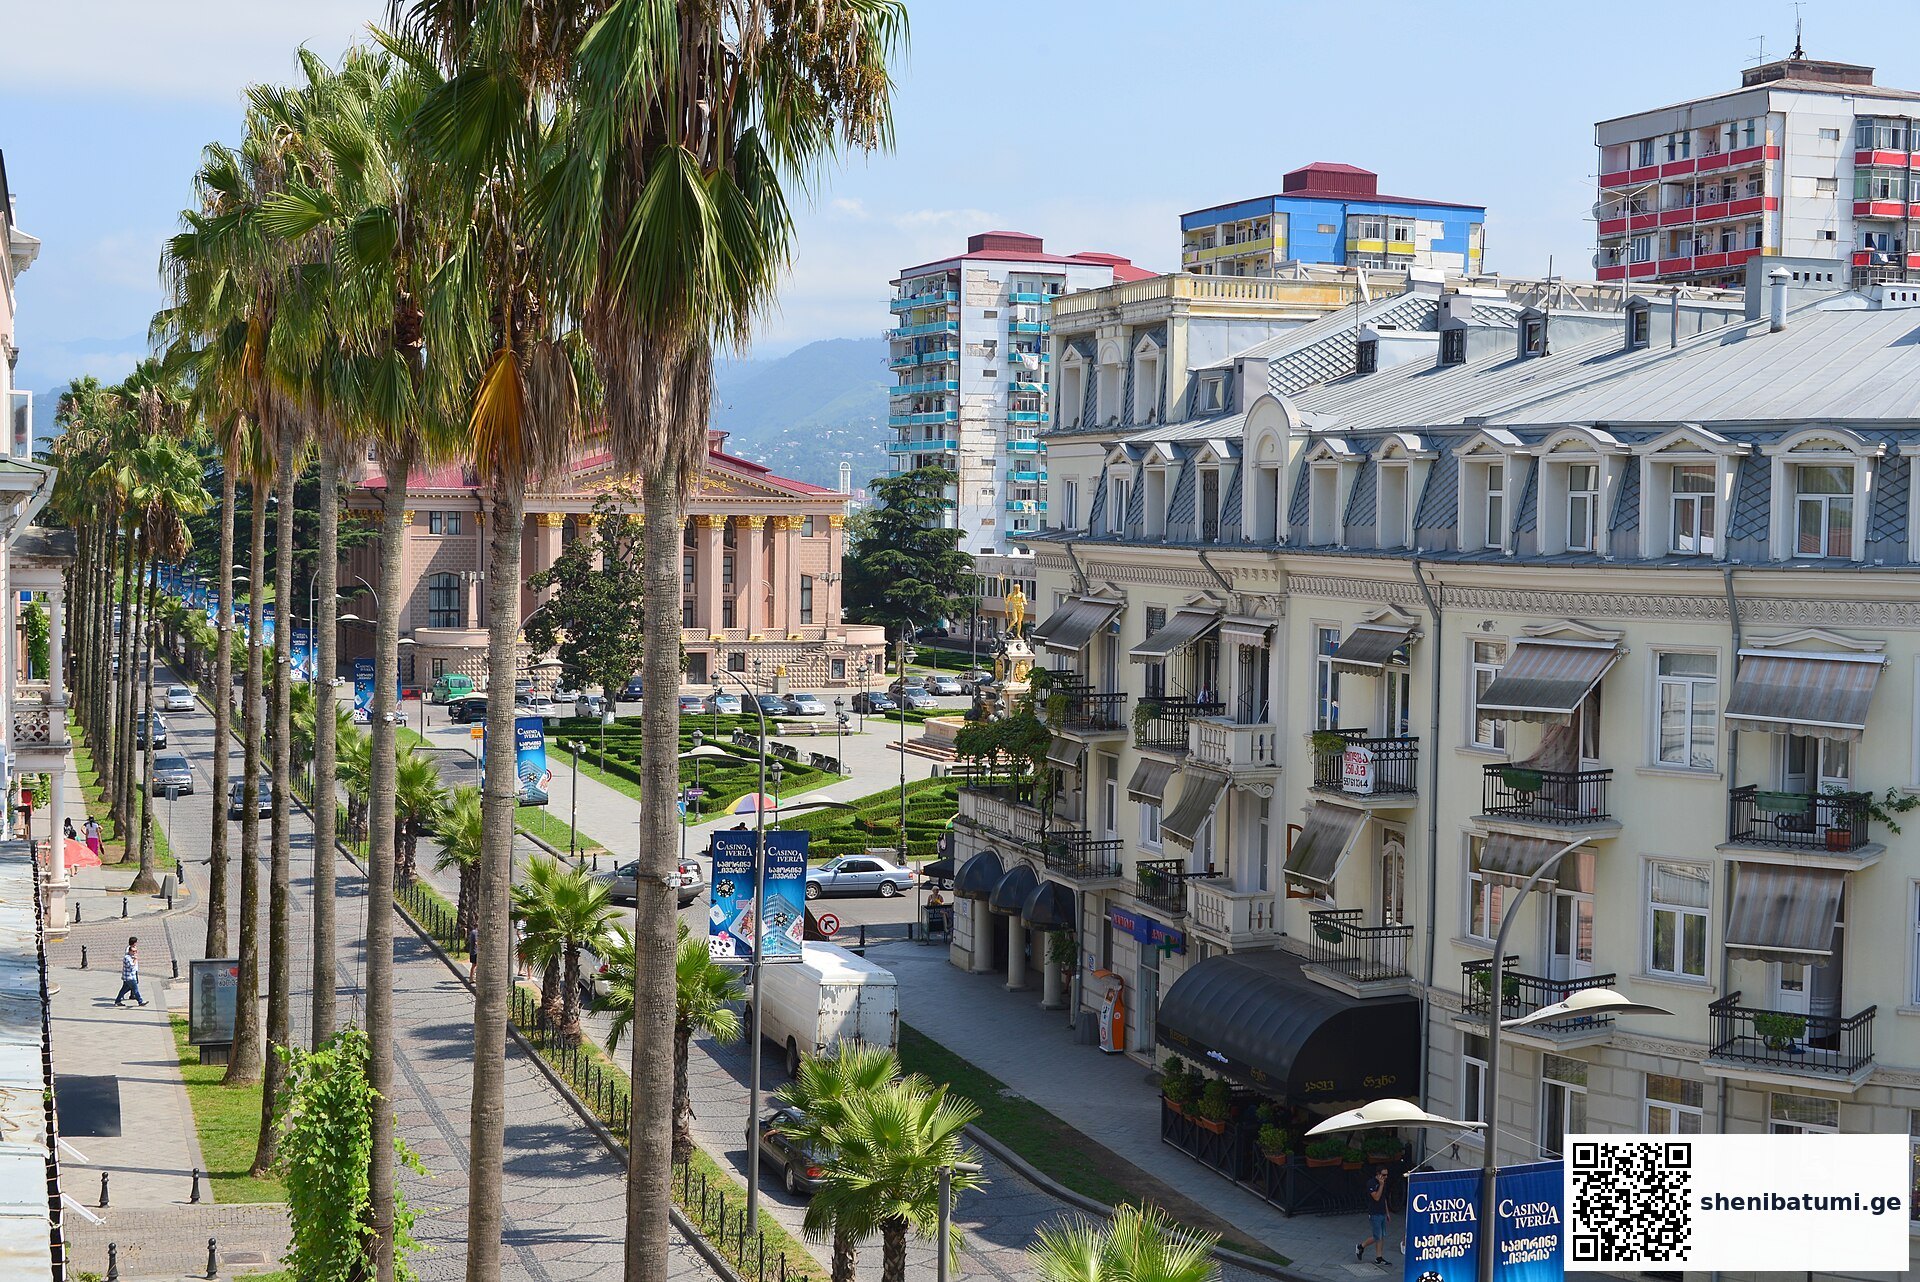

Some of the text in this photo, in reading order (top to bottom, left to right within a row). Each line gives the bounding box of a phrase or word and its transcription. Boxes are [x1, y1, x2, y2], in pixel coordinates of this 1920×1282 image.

[716, 841, 747, 850] CASINO
[726, 847, 753, 856] IVERIA
[768, 847, 798, 856] CASINO
[777, 853, 804, 862] IVERIA
[1412, 1194, 1466, 1213] CASINO
[1498, 1199, 1550, 1218] CASINO
[1429, 1203, 1477, 1224] IVERIA
[1515, 1206, 1560, 1229] IVERIA
[1414, 1232, 1473, 1249] სამორინე
[1501, 1235, 1558, 1253] სამორინე
